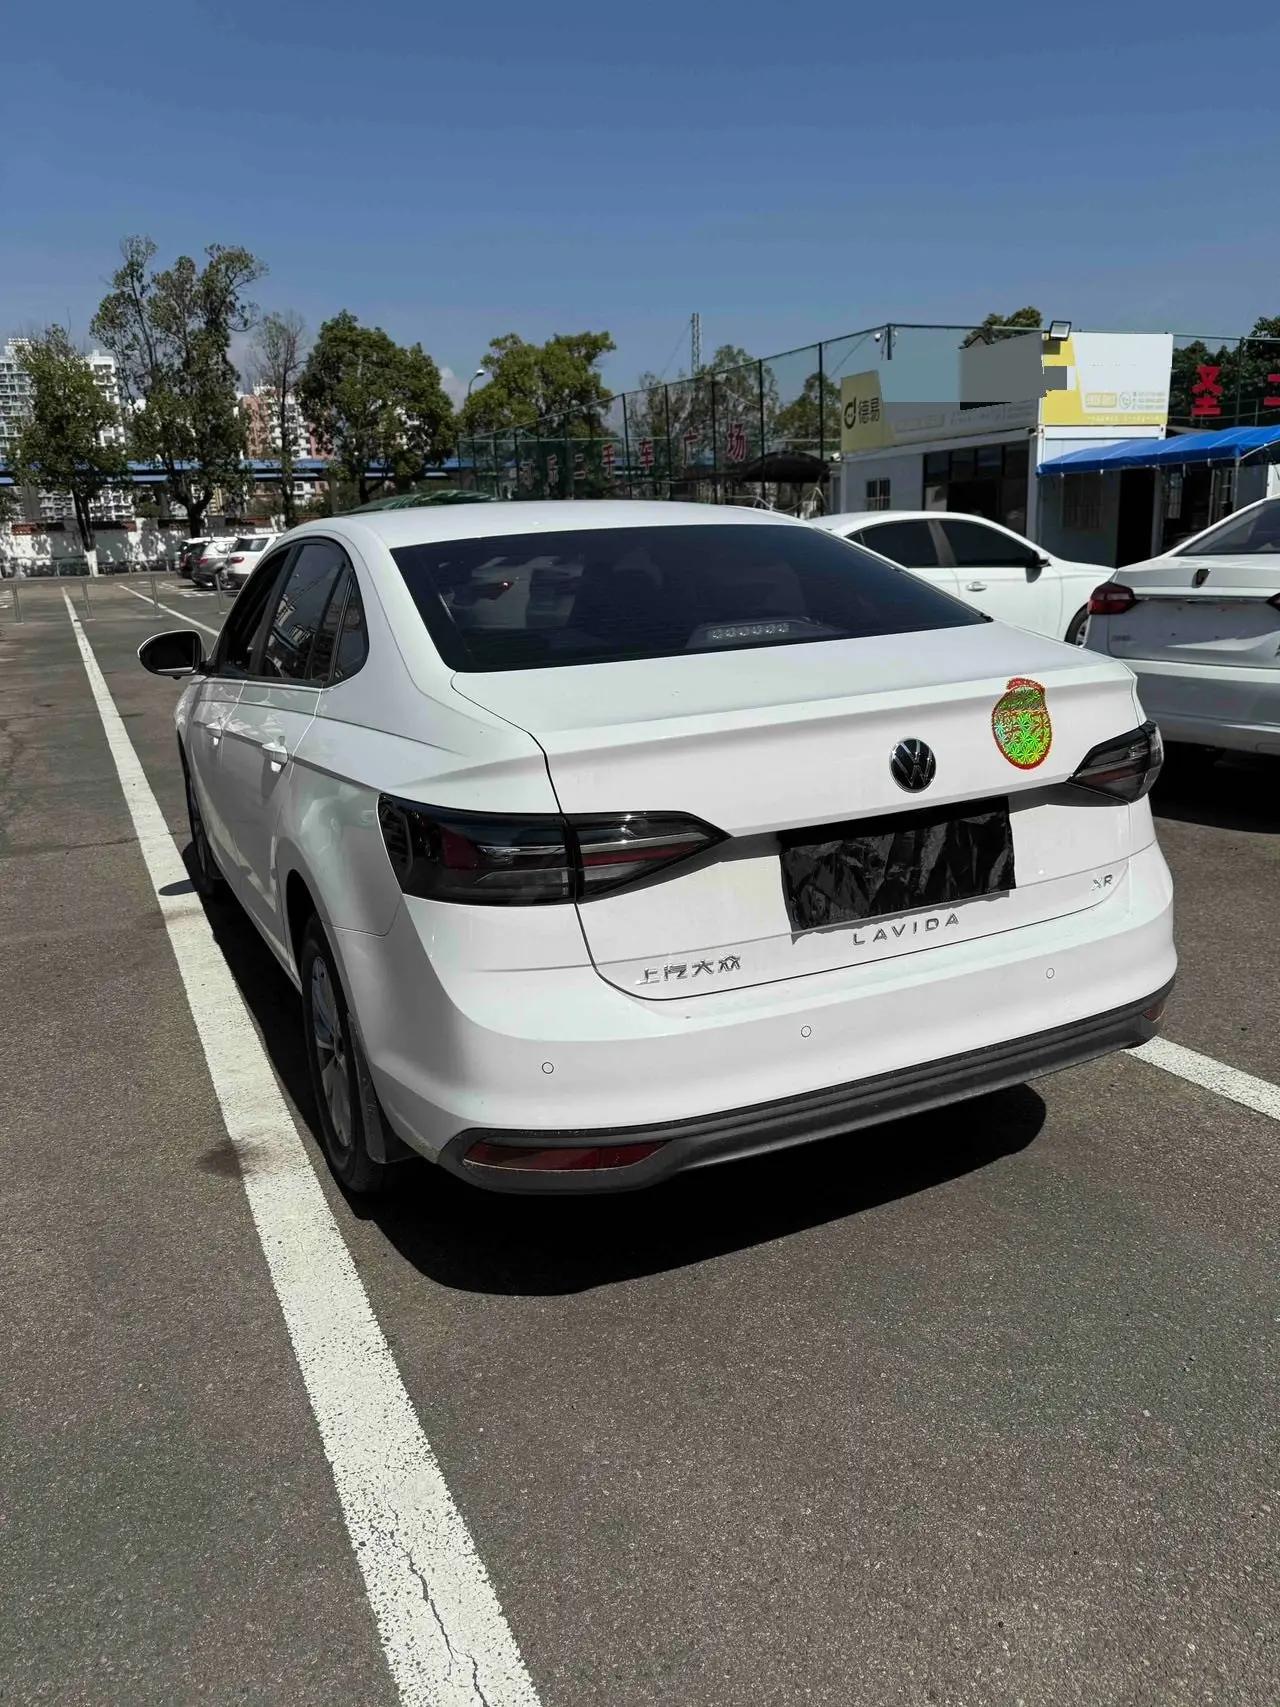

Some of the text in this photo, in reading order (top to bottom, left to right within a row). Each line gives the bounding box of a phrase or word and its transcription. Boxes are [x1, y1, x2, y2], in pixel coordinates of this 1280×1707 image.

[852, 912, 960, 946] LAVIDA
[635, 954, 742, 986] 上汽大众
